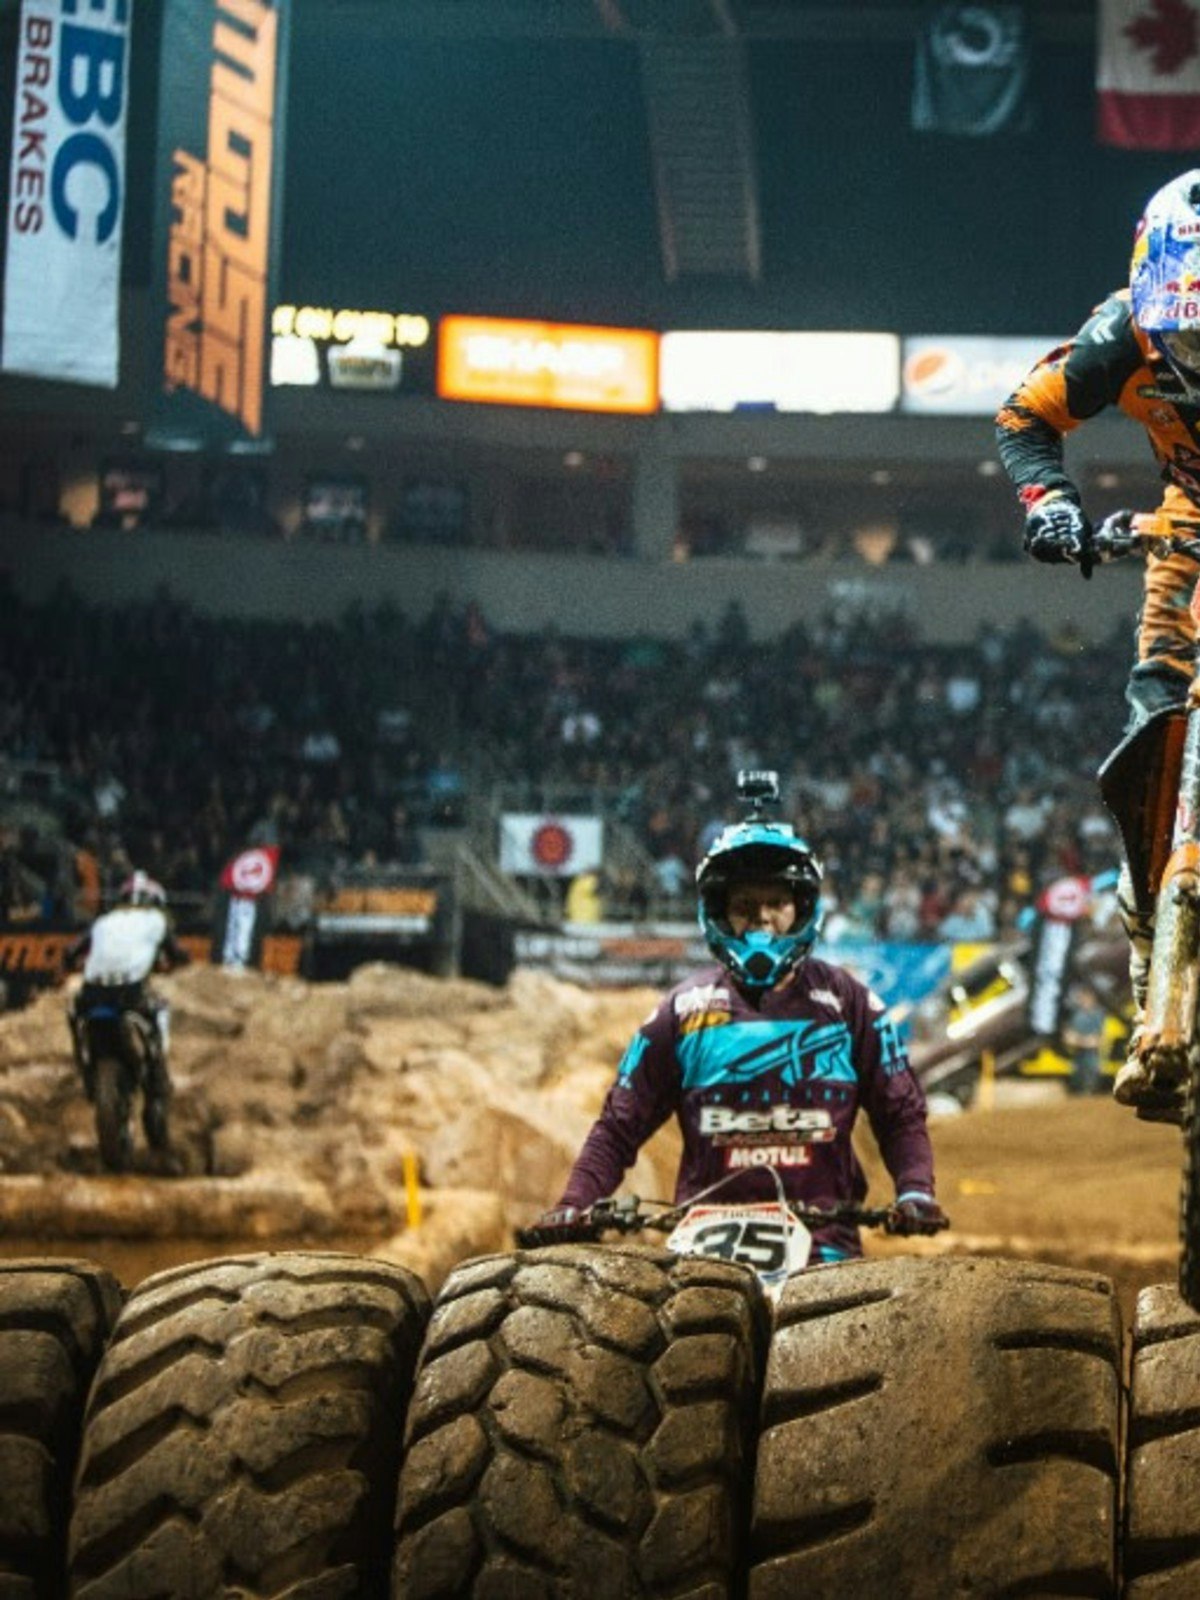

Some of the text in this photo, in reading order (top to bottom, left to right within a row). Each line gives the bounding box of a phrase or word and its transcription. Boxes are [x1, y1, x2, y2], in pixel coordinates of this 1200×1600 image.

[14, 15, 52, 234] BRAKES
[51, 0, 125, 245] BC
[198, 0, 278, 437] MOOSE
[166, 148, 209, 395] RACING
[699, 1103, 831, 1135] Beta
[728, 1146, 810, 1169] MOTUL
[692, 1220, 796, 1271] 35
